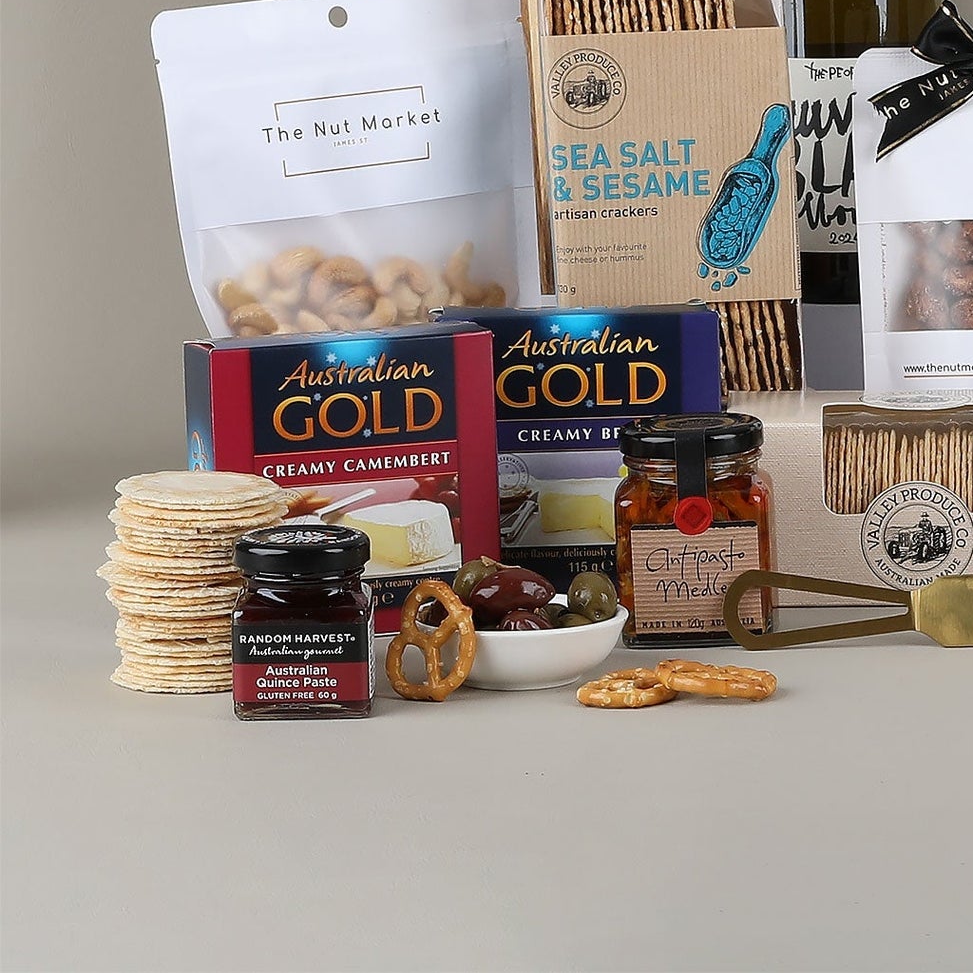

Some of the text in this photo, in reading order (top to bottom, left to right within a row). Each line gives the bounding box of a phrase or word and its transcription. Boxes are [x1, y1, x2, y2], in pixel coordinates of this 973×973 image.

[550, 57, 573, 99] VALLEY
[573, 52, 620, 80] PRODUCE
[262, 107, 442, 144] The Nut Market
[552, 139, 696, 171] SEA SALT
[553, 169, 711, 202] & SESAME
[554, 205, 658, 221] artisan crackers
[501, 326, 659, 359] Australian
[278, 352, 435, 391] Australian
[496, 362, 668, 408] GOLD
[272, 387, 443, 442] GOLD
[517, 428, 593, 442] CREAMY
[262, 451, 451, 479] CREAMY CAMEMBERT
[866, 493, 899, 551] VALLEY
[900, 487, 966, 527] PRODUCE
[563, 547, 607, 558] deliciously
[569, 561, 588, 573] 115
[875, 558, 934, 587] AUSTRALIAN
[385, 578, 413, 590] creamy
[641, 620, 667, 629] MADE
[671, 620, 683, 628] IN
[239, 634, 292, 644] RANDOM
[249, 645, 344, 660] Australian gourmet
[265, 664, 328, 676] Australian
[256, 677, 338, 689] Quince Paste
[257, 691, 337, 701] GLUTEN FREE 60 g
